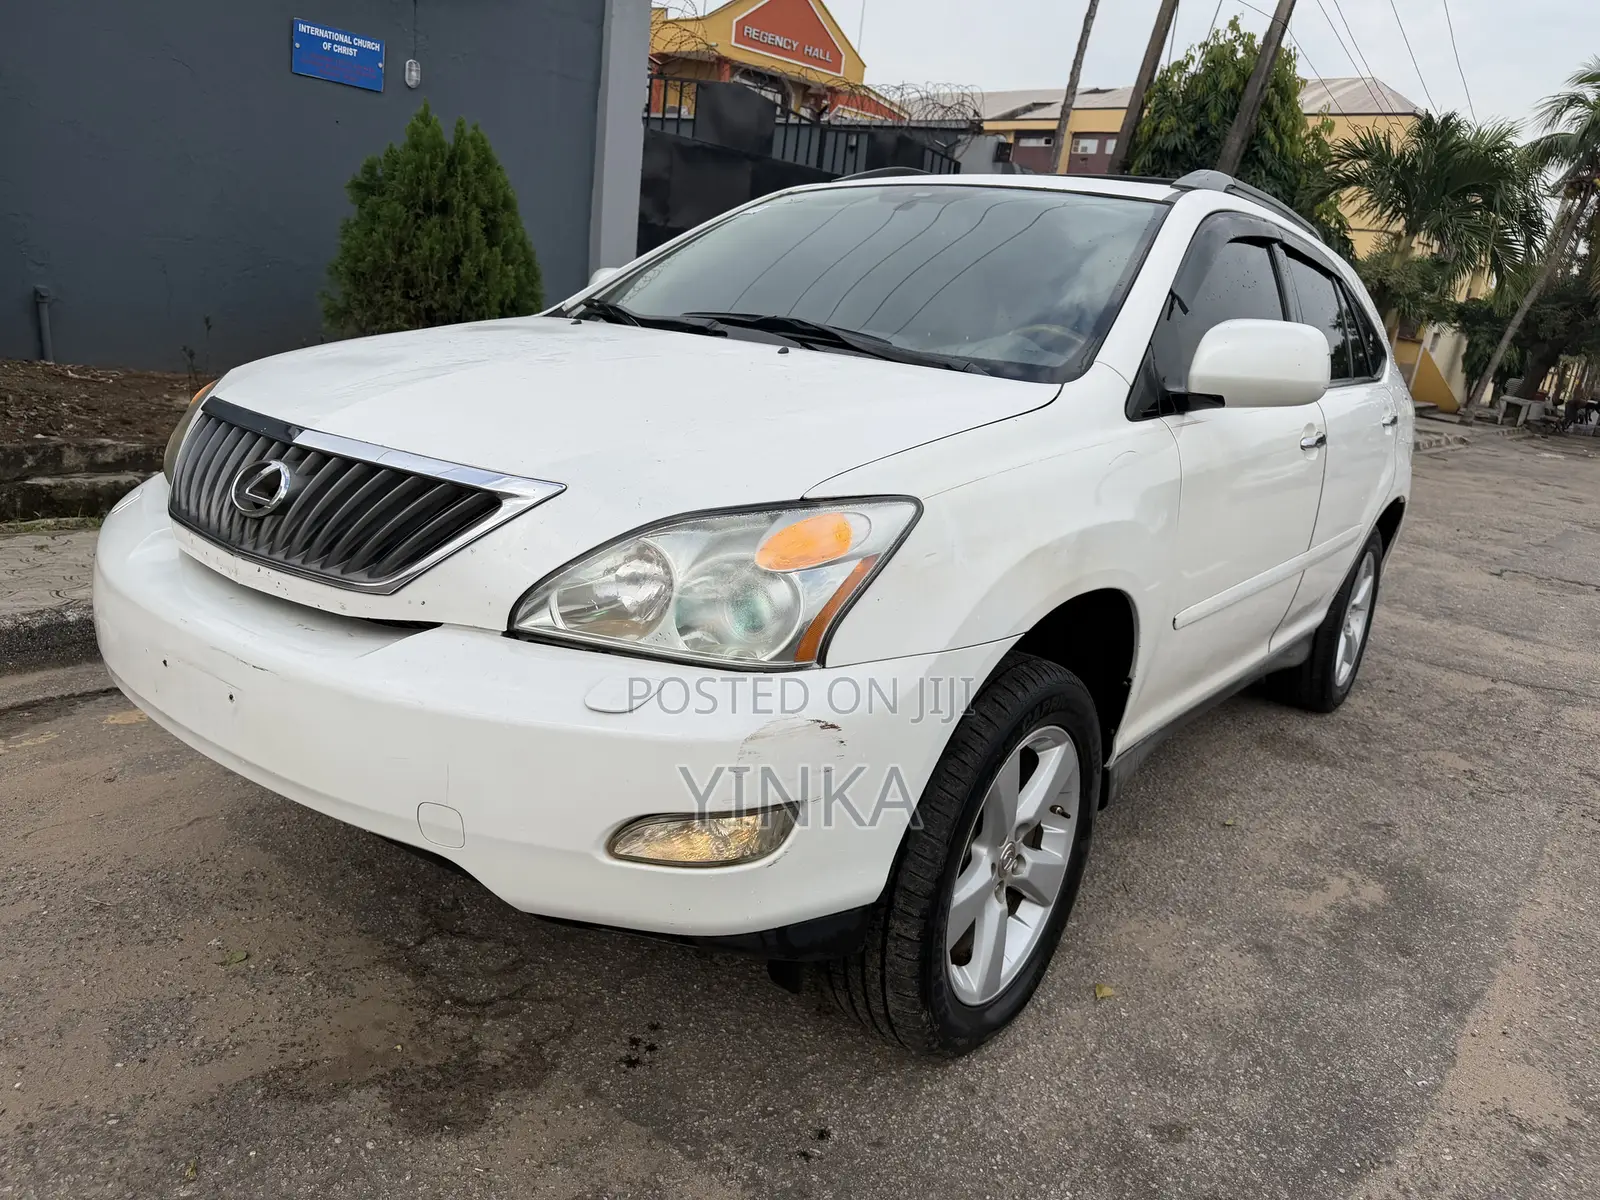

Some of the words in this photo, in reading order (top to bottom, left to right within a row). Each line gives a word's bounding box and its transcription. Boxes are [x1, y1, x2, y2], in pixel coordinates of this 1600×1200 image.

[298, 23, 352, 45] INTERNATIONAL
[353, 37, 381, 52] CHURCH
[322, 41, 332, 51] OF
[332, 44, 358, 57] CHRIST
[743, 25, 799, 52] REGENCY
[804, 44, 833, 63] HALL
